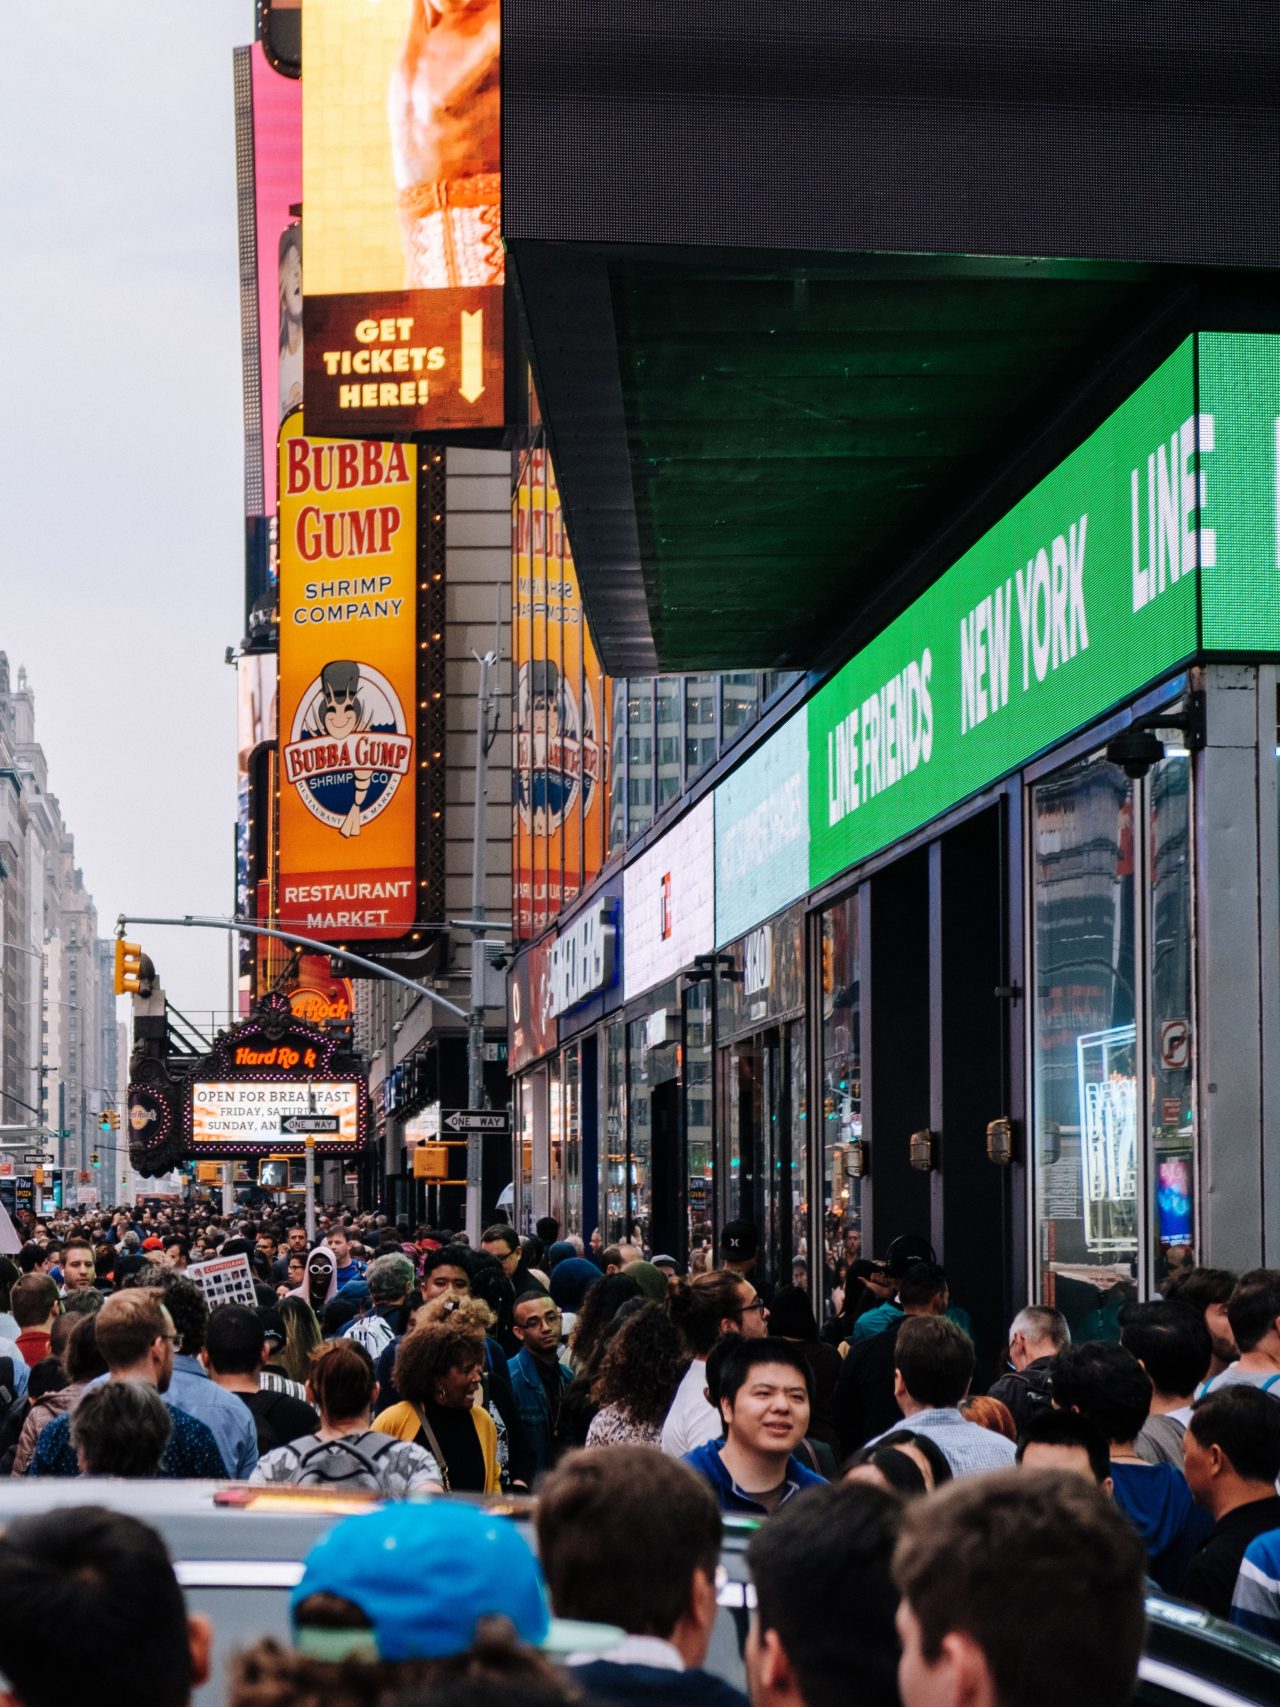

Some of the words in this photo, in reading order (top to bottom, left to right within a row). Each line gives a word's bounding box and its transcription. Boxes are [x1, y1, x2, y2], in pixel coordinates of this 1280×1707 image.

[355, 317, 415, 344] GET
[323, 346, 446, 375] TICKETS
[339, 379, 429, 408] HERE!
[287, 438, 410, 495] BUBBA
[1131, 413, 1217, 614] LINE
[295, 506, 401, 561] GUMP
[306, 576, 392, 599] SHRIMP
[294, 599, 402, 625] COMPANY
[959, 576, 1012, 736] NEW
[1013, 512, 1090, 691] YORK
[828, 707, 860, 828] LINE
[861, 646, 934, 807] FRIENDS
[289, 741, 352, 777] BUBBA
[355, 735, 408, 769] GUMP
[309, 772, 354, 789] SHRIMP
[298, 781, 342, 825] RESTAURANT
[370, 778, 398, 815] MARKET
[284, 881, 412, 904] RESTAURANT
[307, 910, 389, 929] MARKET
[309, 999, 349, 1020] Rock
[236, 1047, 277, 1066] Hard
[277, 1048, 317, 1069] Rok
[197, 1091, 235, 1103] OPEN
[239, 1091, 267, 1103] FOR
[271, 1091, 351, 1103] BREAFAST
[220, 1107, 266, 1119] FRIDAY,
[288, 1120, 306, 1129] ONE
[314, 1120, 333, 1129] WAY
[451, 1117, 471, 1126] ONE
[480, 1117, 501, 1126] WAY
[207, 1120, 258, 1132] SUNDAY,
